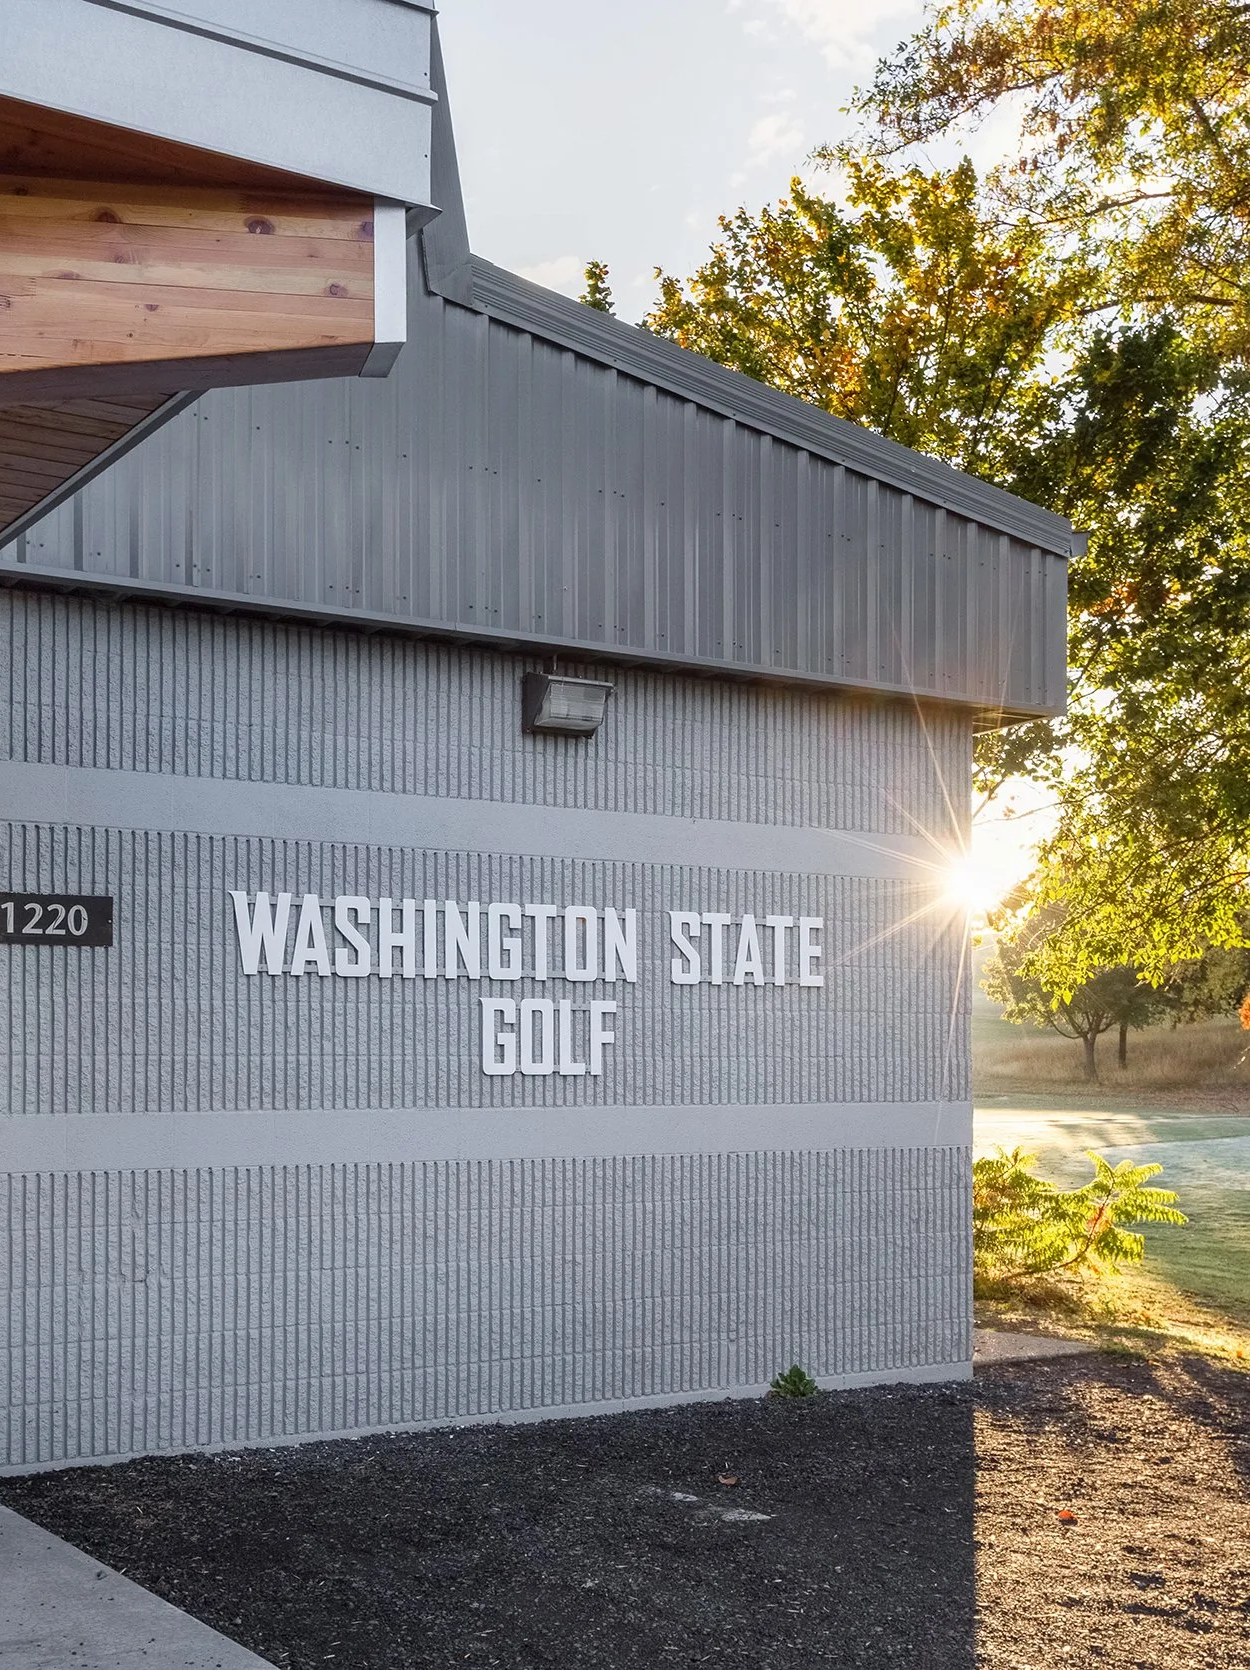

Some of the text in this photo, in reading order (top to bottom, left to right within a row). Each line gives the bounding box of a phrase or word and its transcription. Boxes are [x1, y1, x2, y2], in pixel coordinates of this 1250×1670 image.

[0, 901, 89, 936] 1220
[227, 889, 824, 987] WASHINGTON STATE
[479, 997, 617, 1076] GOLF
